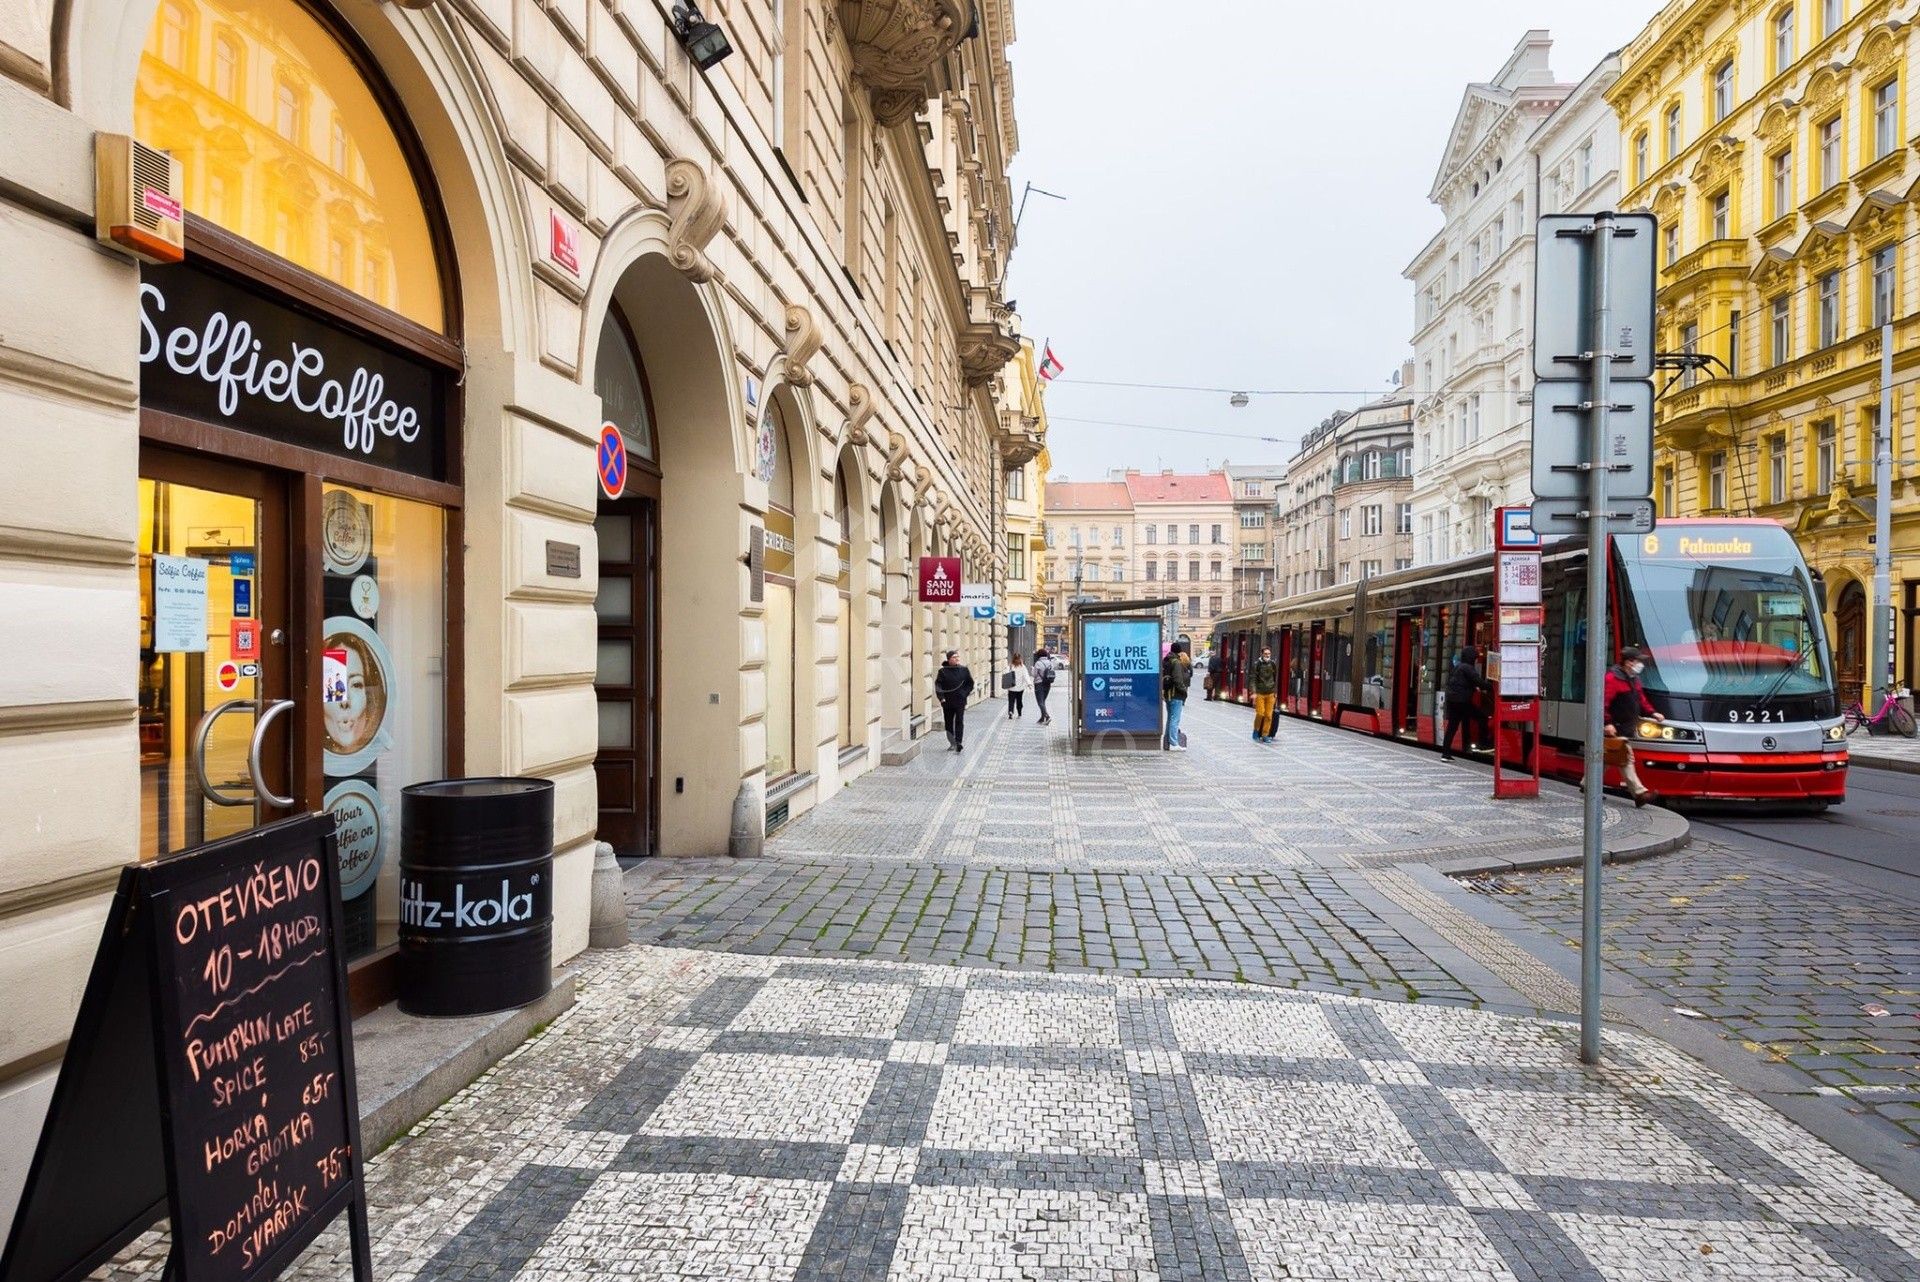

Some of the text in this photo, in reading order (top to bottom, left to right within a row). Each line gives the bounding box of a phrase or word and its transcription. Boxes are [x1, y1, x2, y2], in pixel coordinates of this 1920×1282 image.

[1644, 536, 1752, 554] 6 Palmovka
[926, 580, 954, 588] SANU
[1091, 646, 1147, 660] Být u PRE
[1091, 659, 1153, 671] má SMYSL
[1729, 710, 1785, 723] 9221
[334, 806, 363, 828] Your
[361, 826, 374, 838] on
[176, 859, 320, 945] OTEVŘENO
[186, 1001, 314, 1082] PUMPKIN LATE
[212, 1055, 267, 1107] SPICE
[205, 1093, 269, 1172] HORKÁ
[247, 1112, 313, 1176] GRIOTKA
[208, 1164, 279, 1256] DOMÁCÍ
